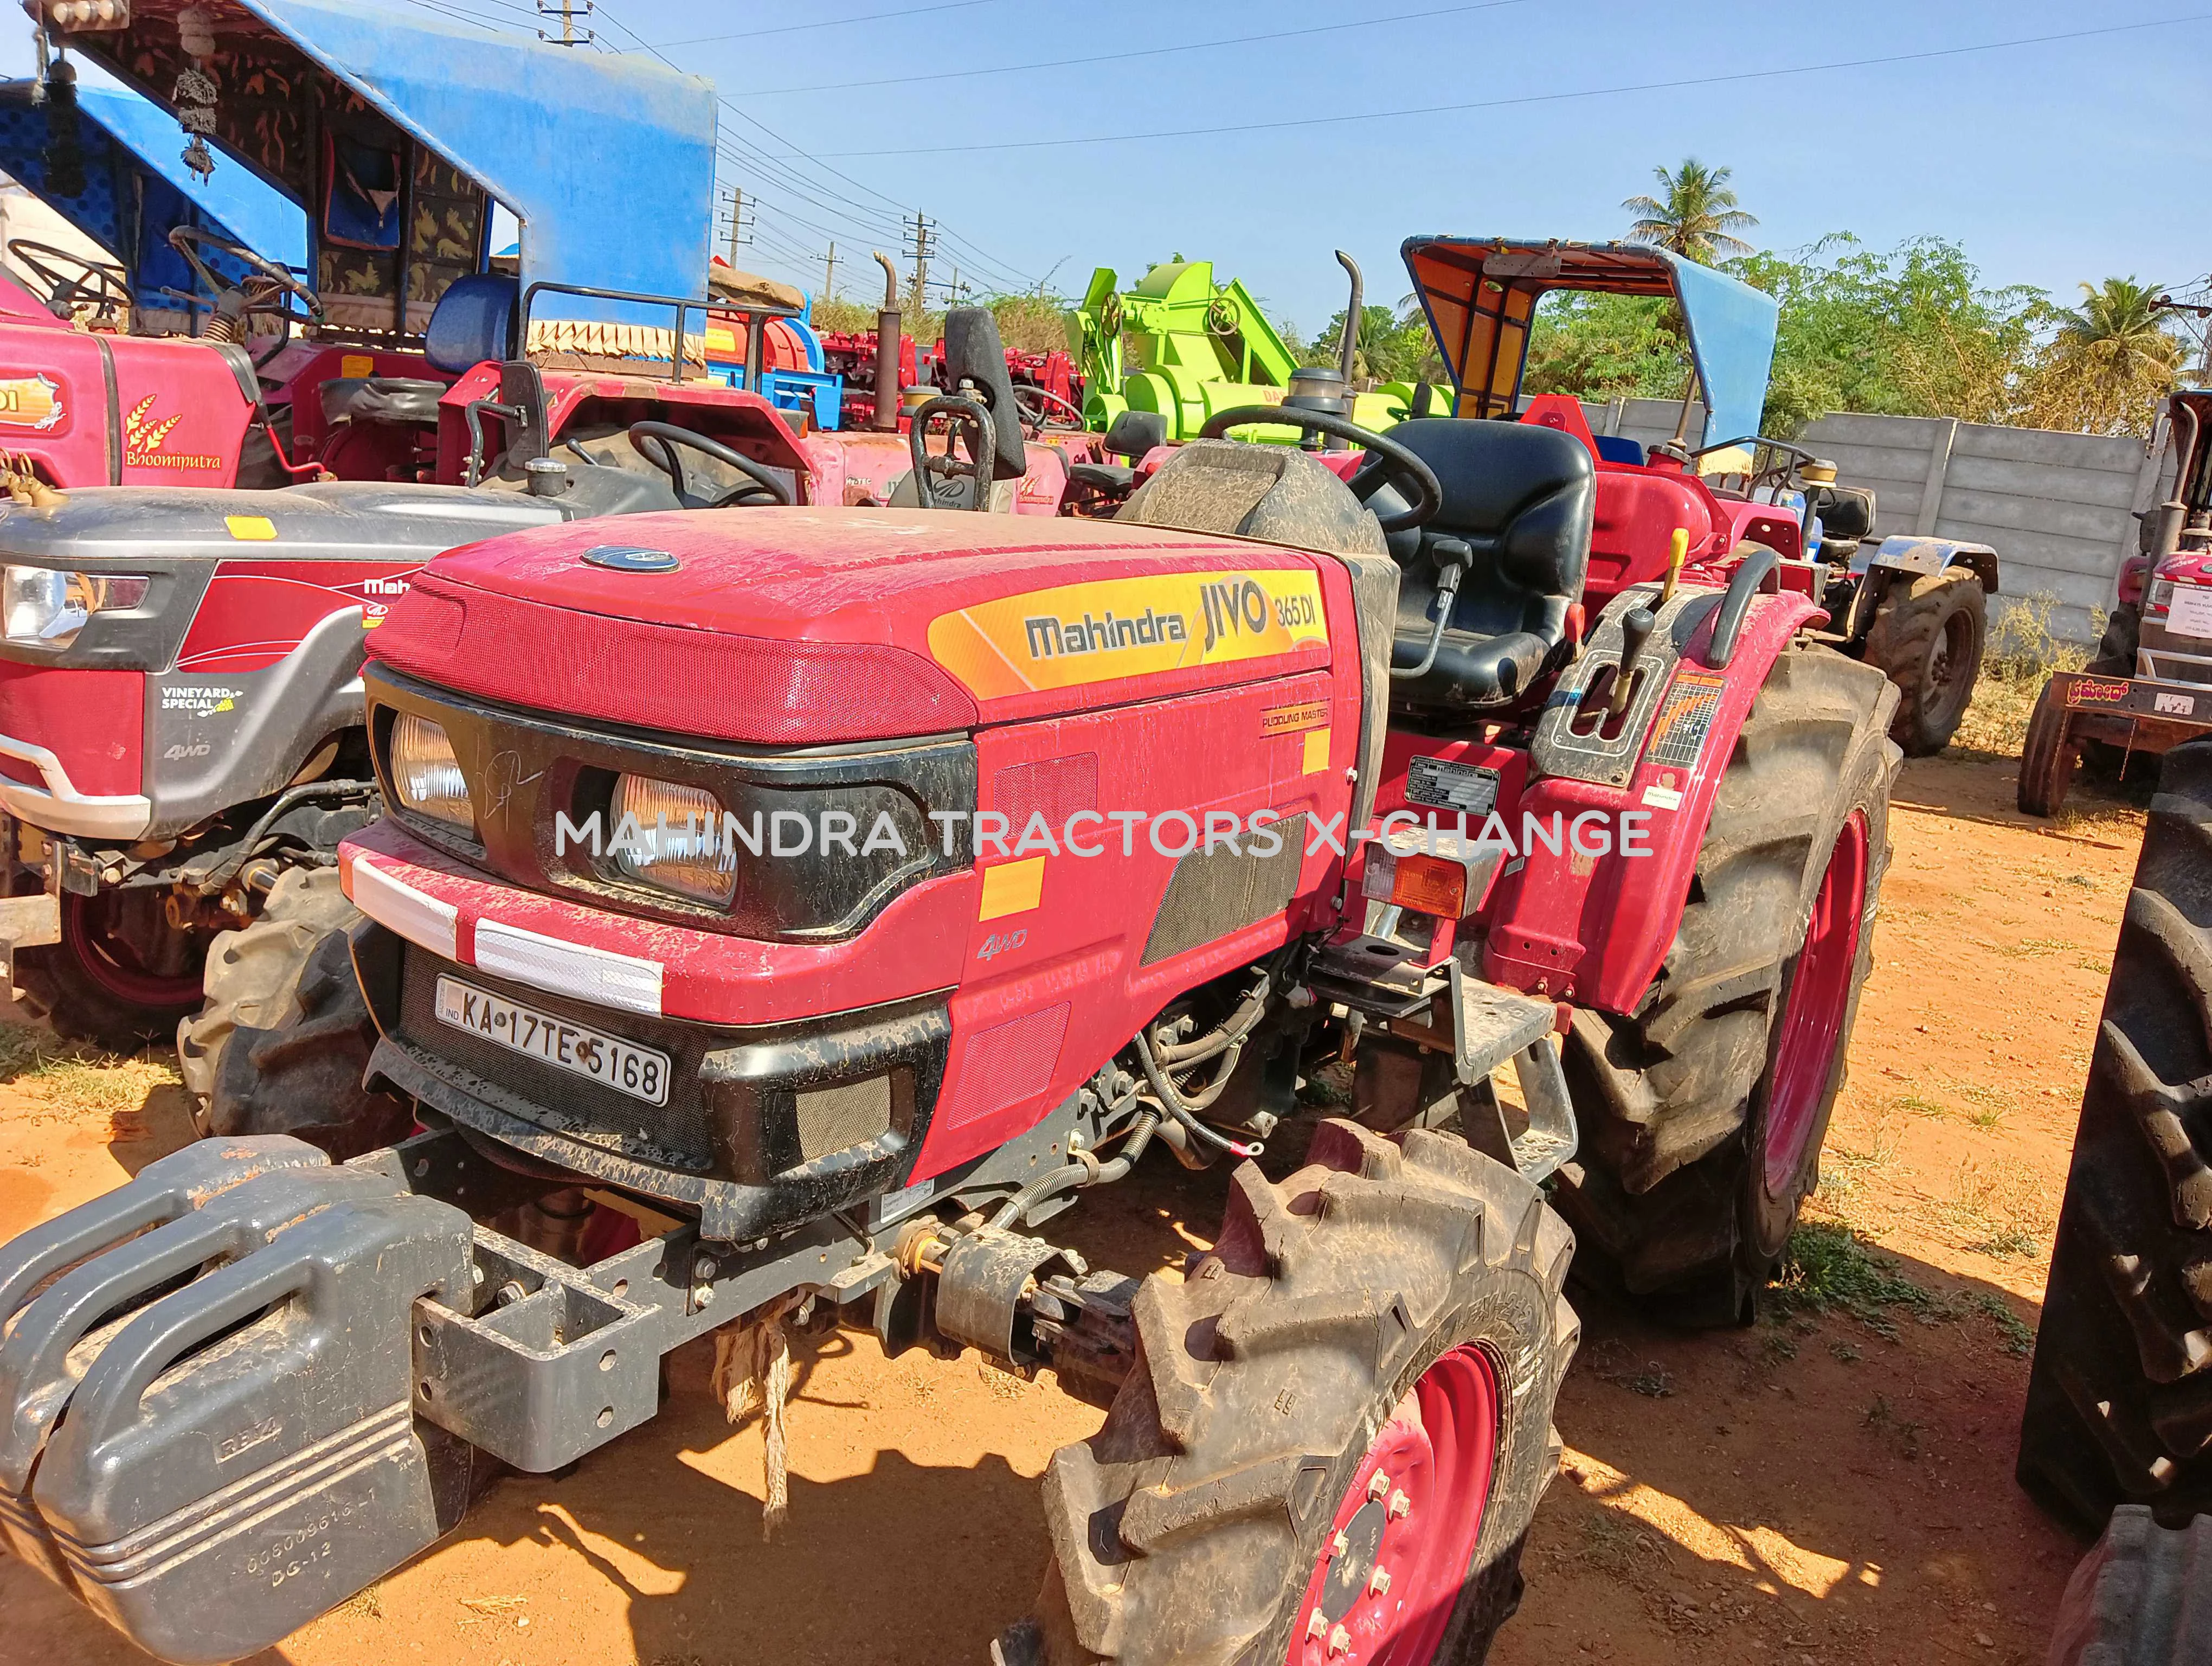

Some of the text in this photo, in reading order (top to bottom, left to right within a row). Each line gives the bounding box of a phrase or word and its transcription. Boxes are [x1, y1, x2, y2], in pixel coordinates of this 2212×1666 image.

[126, 451, 221, 472] Bhoomiputra
[1025, 580, 1317, 659] Mahindra JIVO 365 DI
[162, 687, 230, 698] VINEYARD
[162, 699, 214, 709] SPECIAL
[1262, 707, 1328, 728] PUDDLING MASTER
[164, 744, 211, 760] 4WD
[976, 928, 1028, 962] 4WD
[446, 1008, 459, 1020] IND
